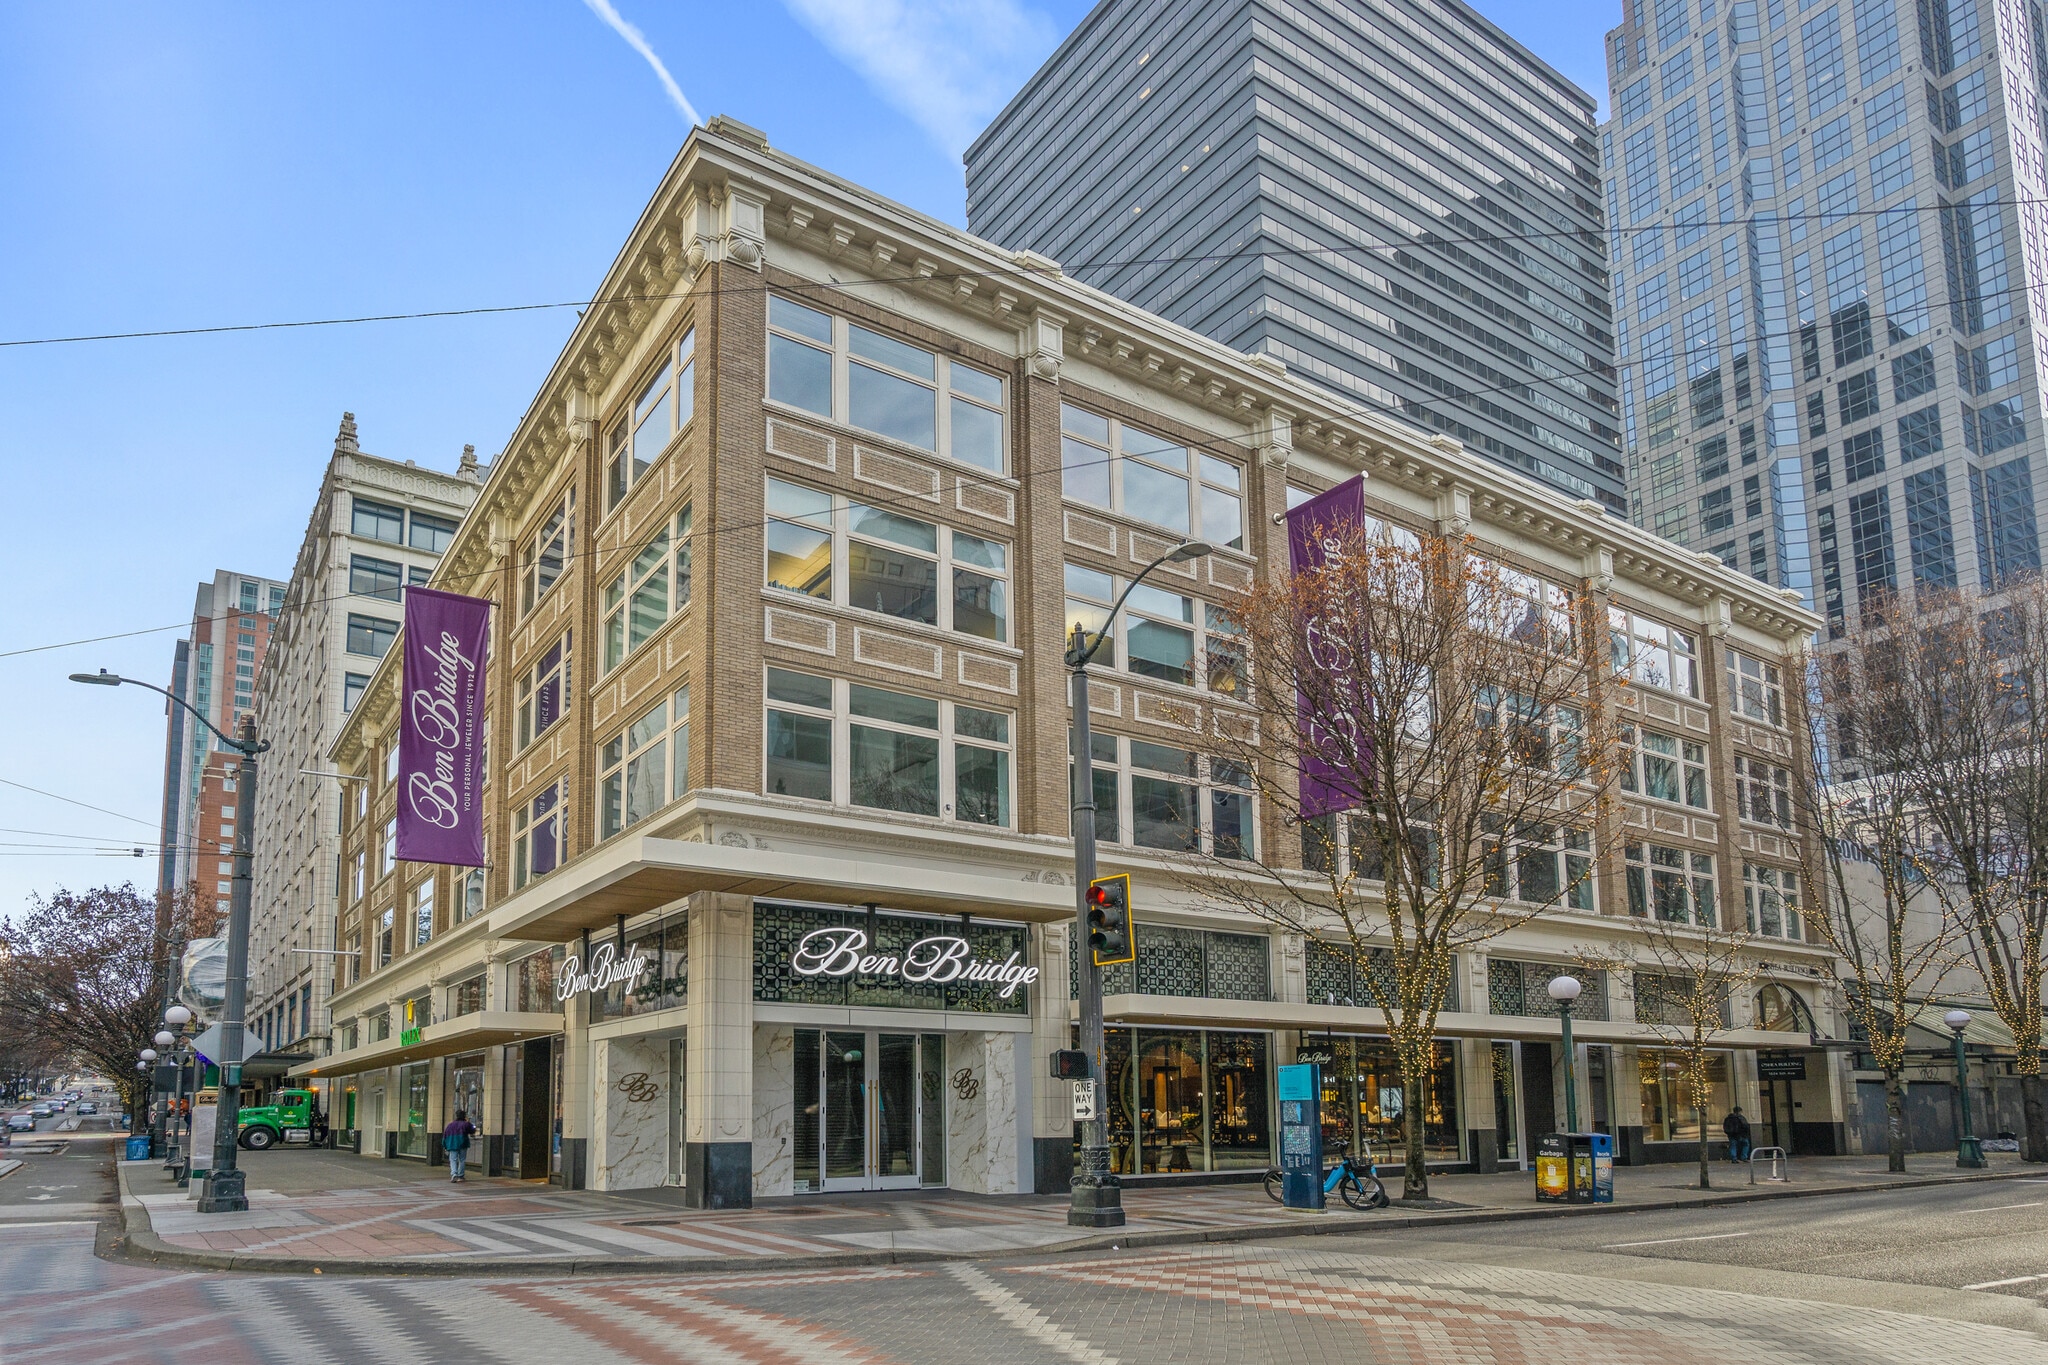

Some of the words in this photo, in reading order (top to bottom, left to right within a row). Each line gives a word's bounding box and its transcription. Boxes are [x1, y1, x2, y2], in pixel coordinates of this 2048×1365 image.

[1306, 537, 1357, 671] Brige
[412, 631, 475, 749] Bridge
[467, 674, 475, 691] 1912
[466, 694, 474, 717] SINCE
[465, 718, 473, 751] JEWELER
[464, 753, 472, 790] PERSONAL
[408, 751, 459, 829] Ben
[557, 955, 589, 1001] Ben
[588, 942, 645, 995] Bridge
[793, 927, 899, 976] Ben
[902, 936, 1040, 999] Bridge
[1074, 1094, 1092, 1104] WAY
[1075, 1082, 1092, 1093] ONE
[1539, 1150, 1564, 1158] Garbage
